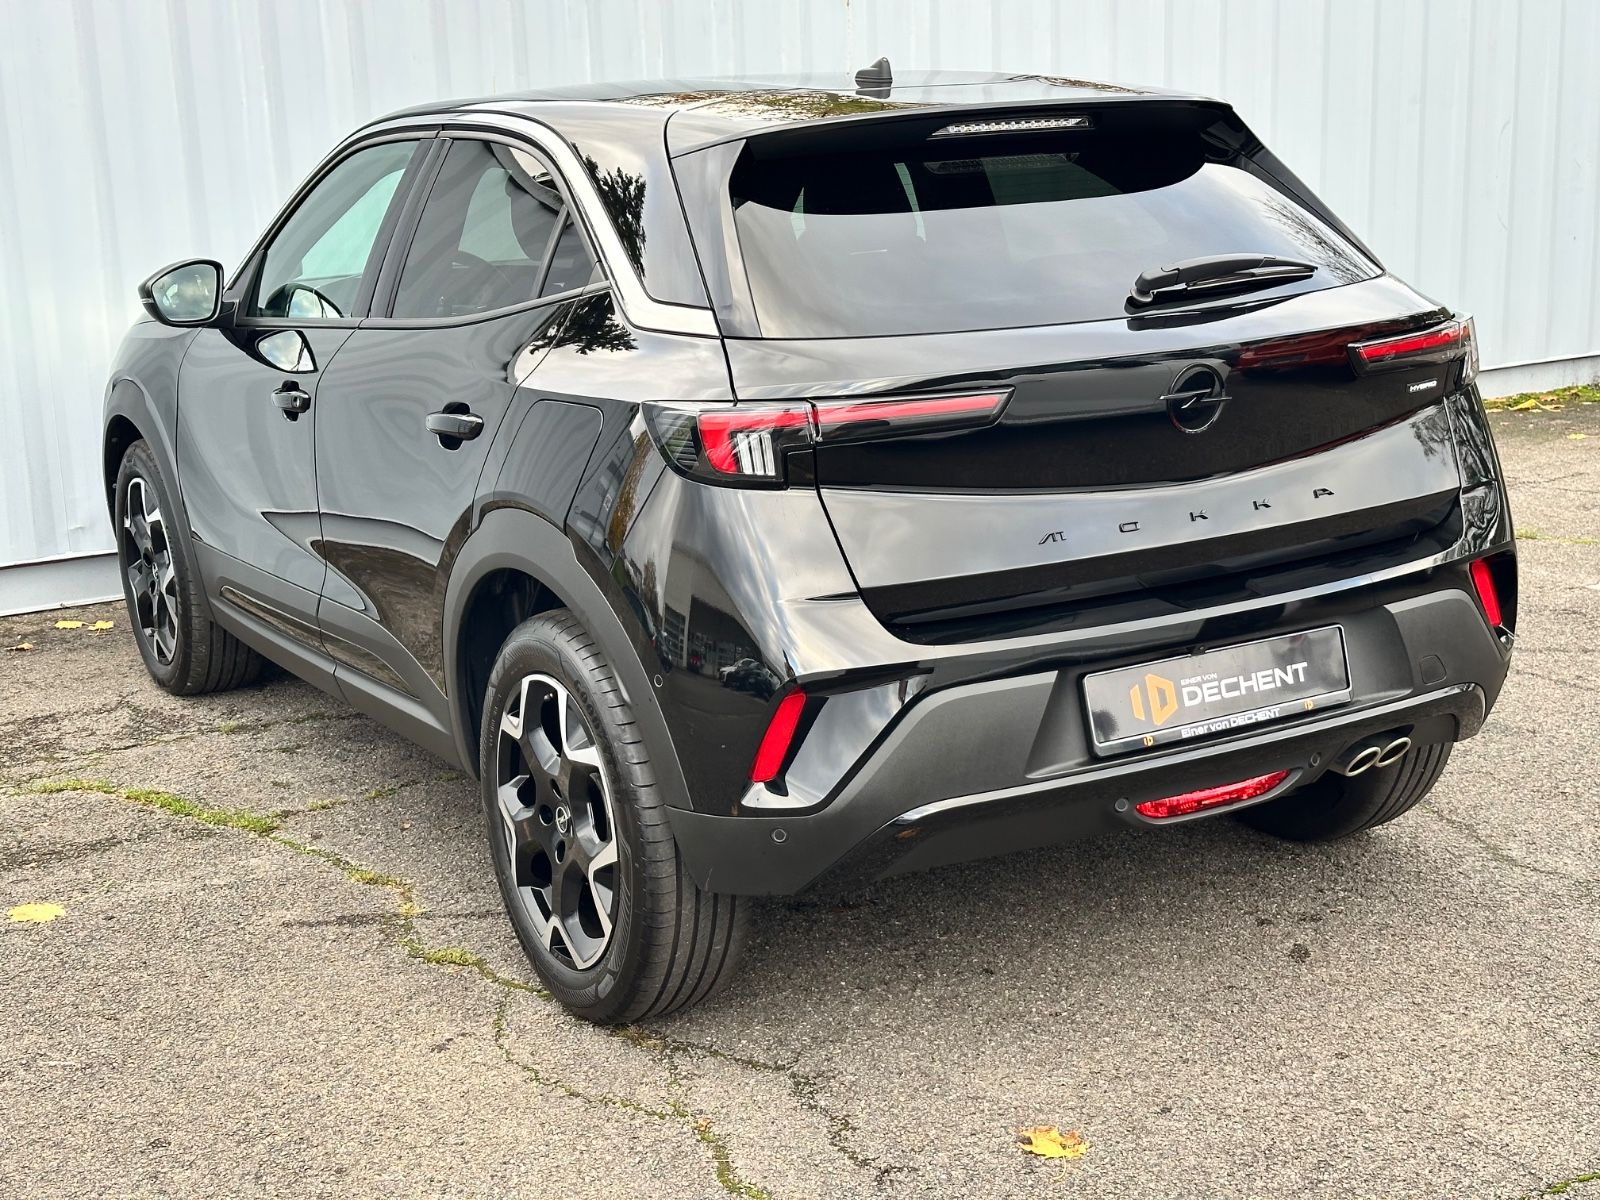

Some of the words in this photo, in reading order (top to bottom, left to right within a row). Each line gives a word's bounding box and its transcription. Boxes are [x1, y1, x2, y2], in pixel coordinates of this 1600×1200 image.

[1182, 662, 1308, 707] DECHENT
[1202, 672, 1218, 681] VON
[1181, 725, 1209, 738] Einer
[1209, 719, 1231, 732] von
[1230, 707, 1281, 726] DECHENT
